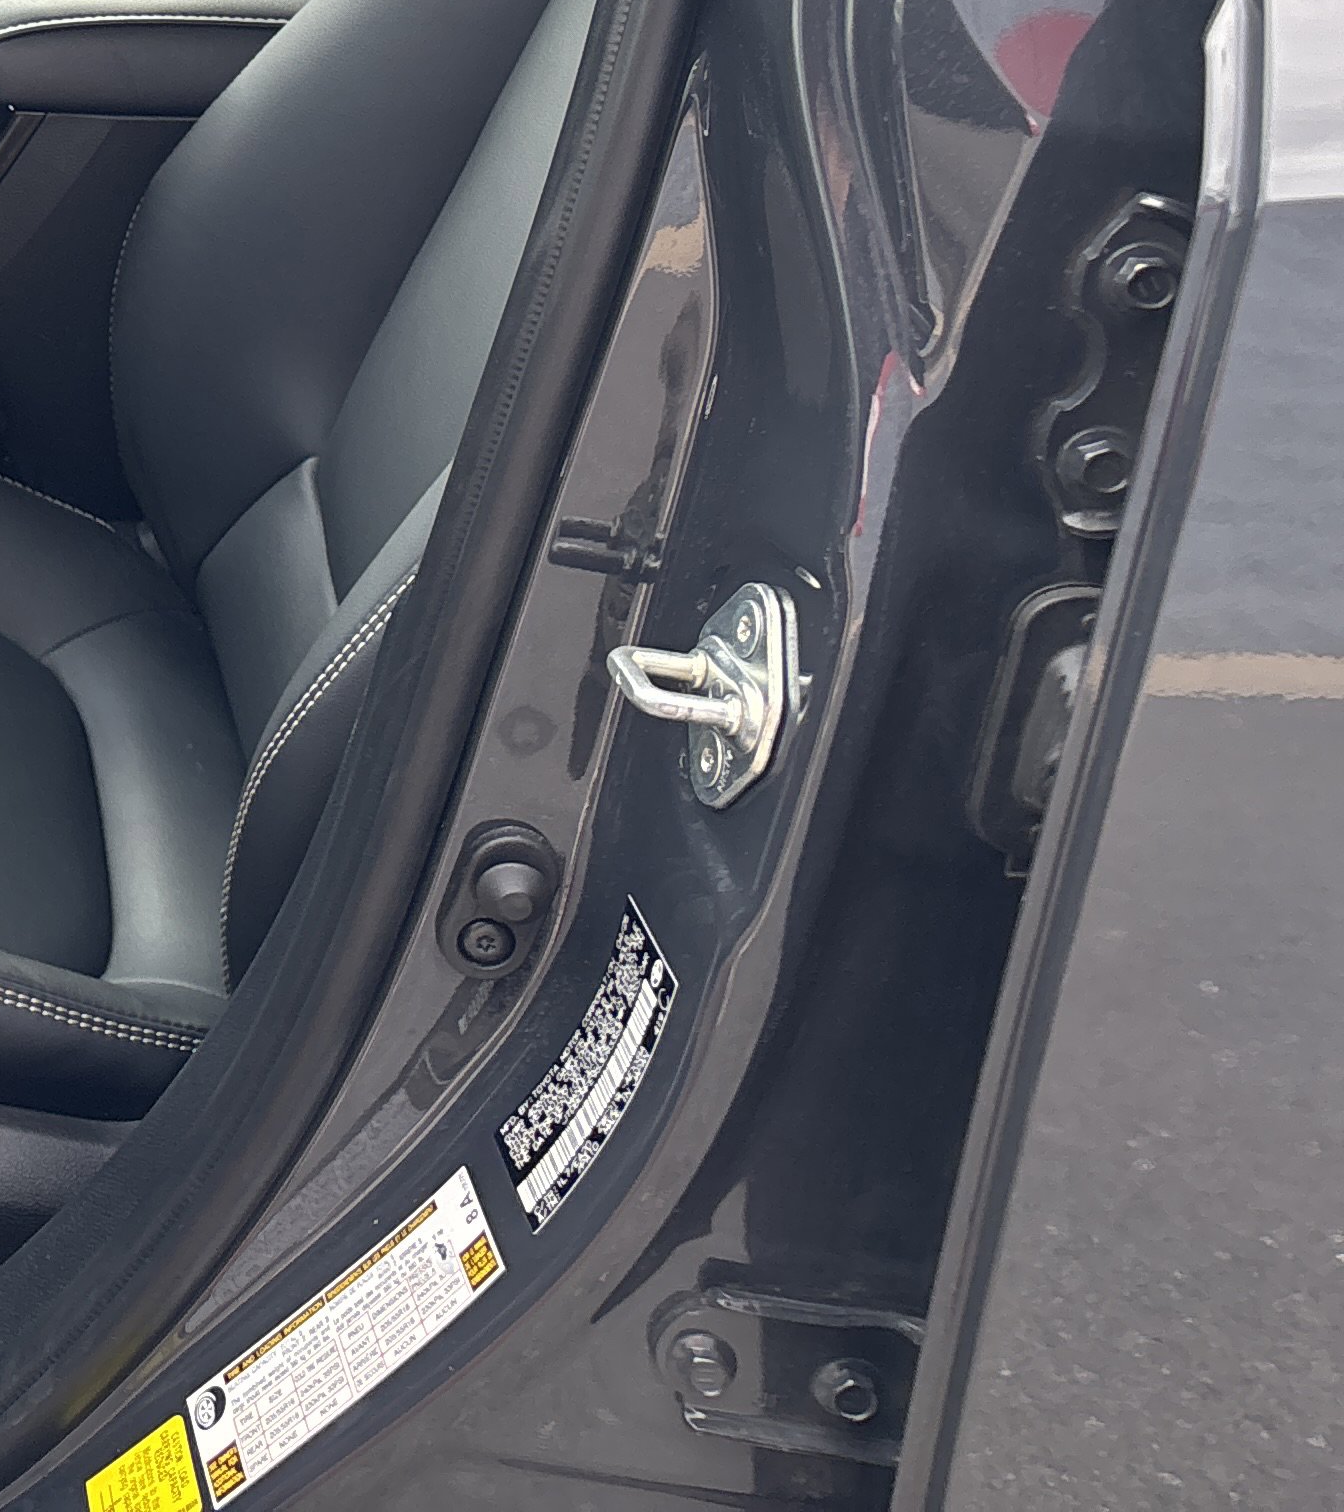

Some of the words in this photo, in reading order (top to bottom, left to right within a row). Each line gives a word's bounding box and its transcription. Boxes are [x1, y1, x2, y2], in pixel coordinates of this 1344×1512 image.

[532, 1064, 559, 1098] TOYOTA
[559, 1029, 581, 1062] MOTOR
[241, 1354, 255, 1369] AND
[255, 1332, 281, 1358] LOADING
[283, 1299, 322, 1336] INFORMATION
[246, 1439, 262, 1457] REAR
